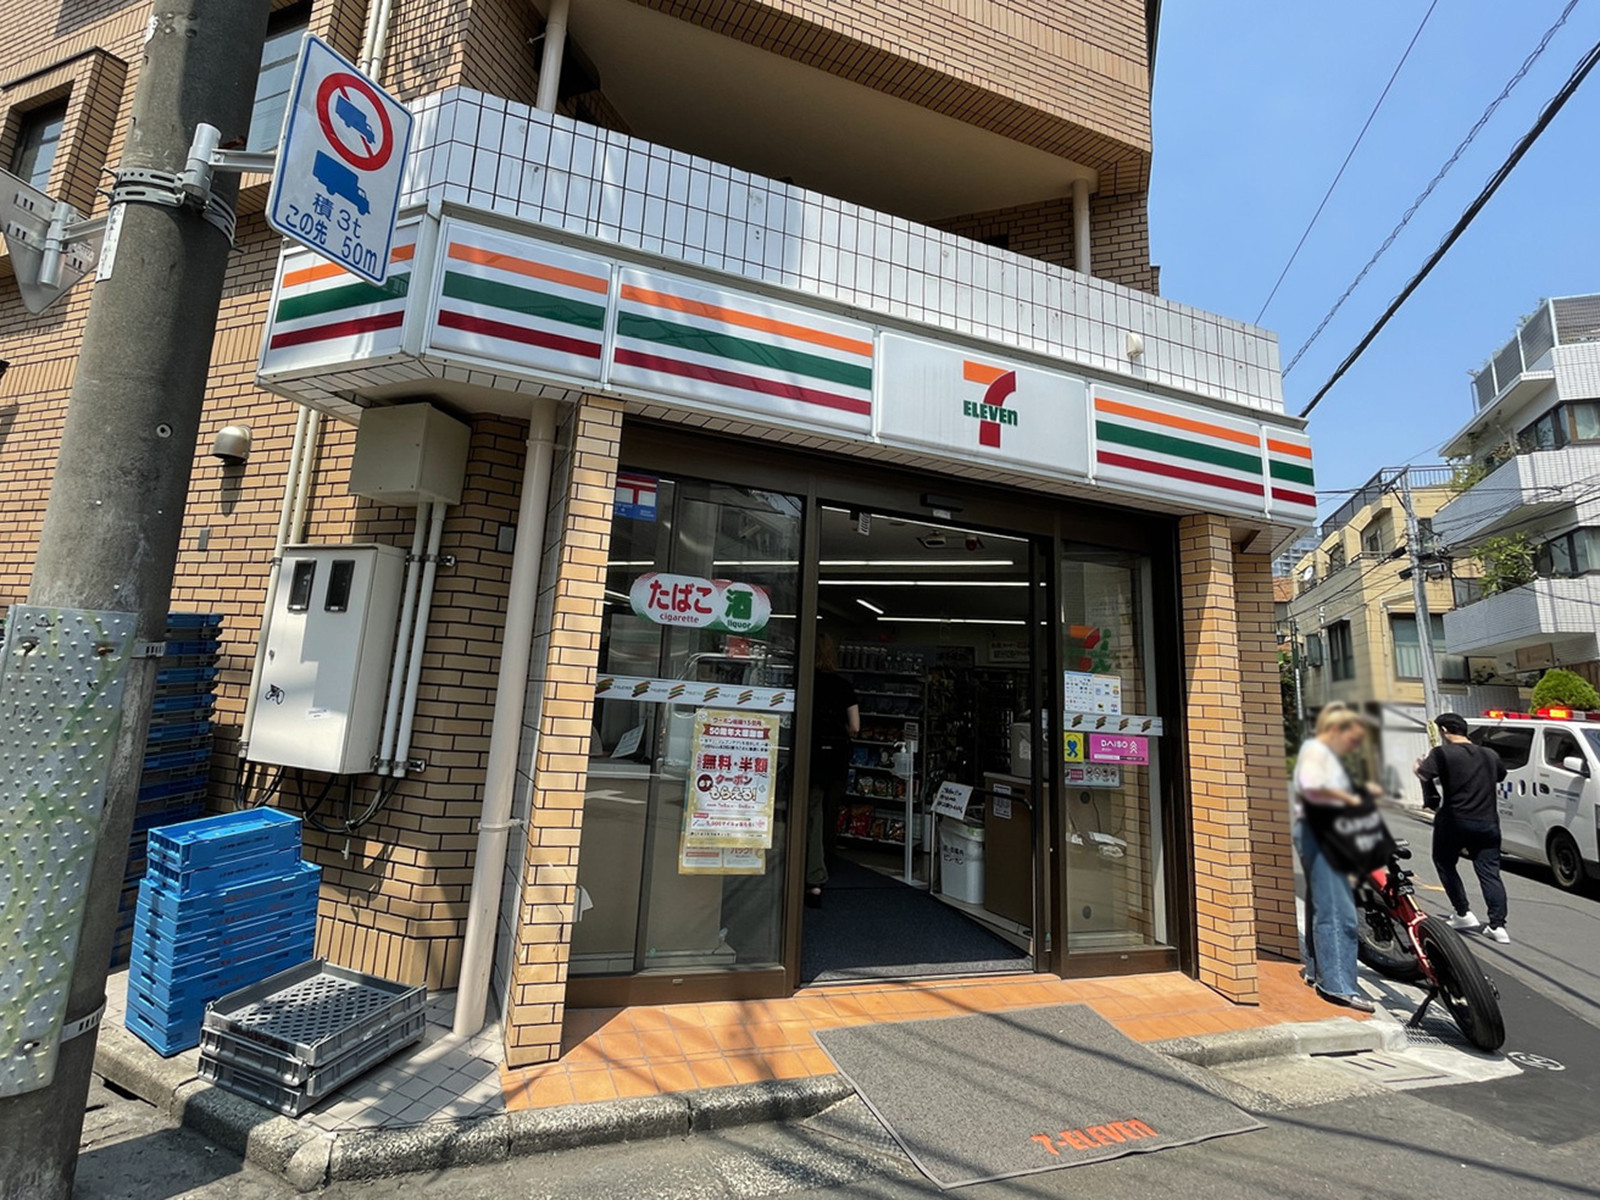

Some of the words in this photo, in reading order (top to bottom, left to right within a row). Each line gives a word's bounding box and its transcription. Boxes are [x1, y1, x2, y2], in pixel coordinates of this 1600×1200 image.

[285, 204, 328, 245] この先
[341, 236, 377, 275] 50m
[648, 579, 713, 615] たばこ
[724, 588, 753, 620] 酒
[659, 612, 700, 624] cigarette
[727, 619, 752, 629] liquor
[1100, 739, 1128, 749] DAISO
[702, 754, 768, 773] 無料・半額
[715, 774, 753, 786] クーポン
